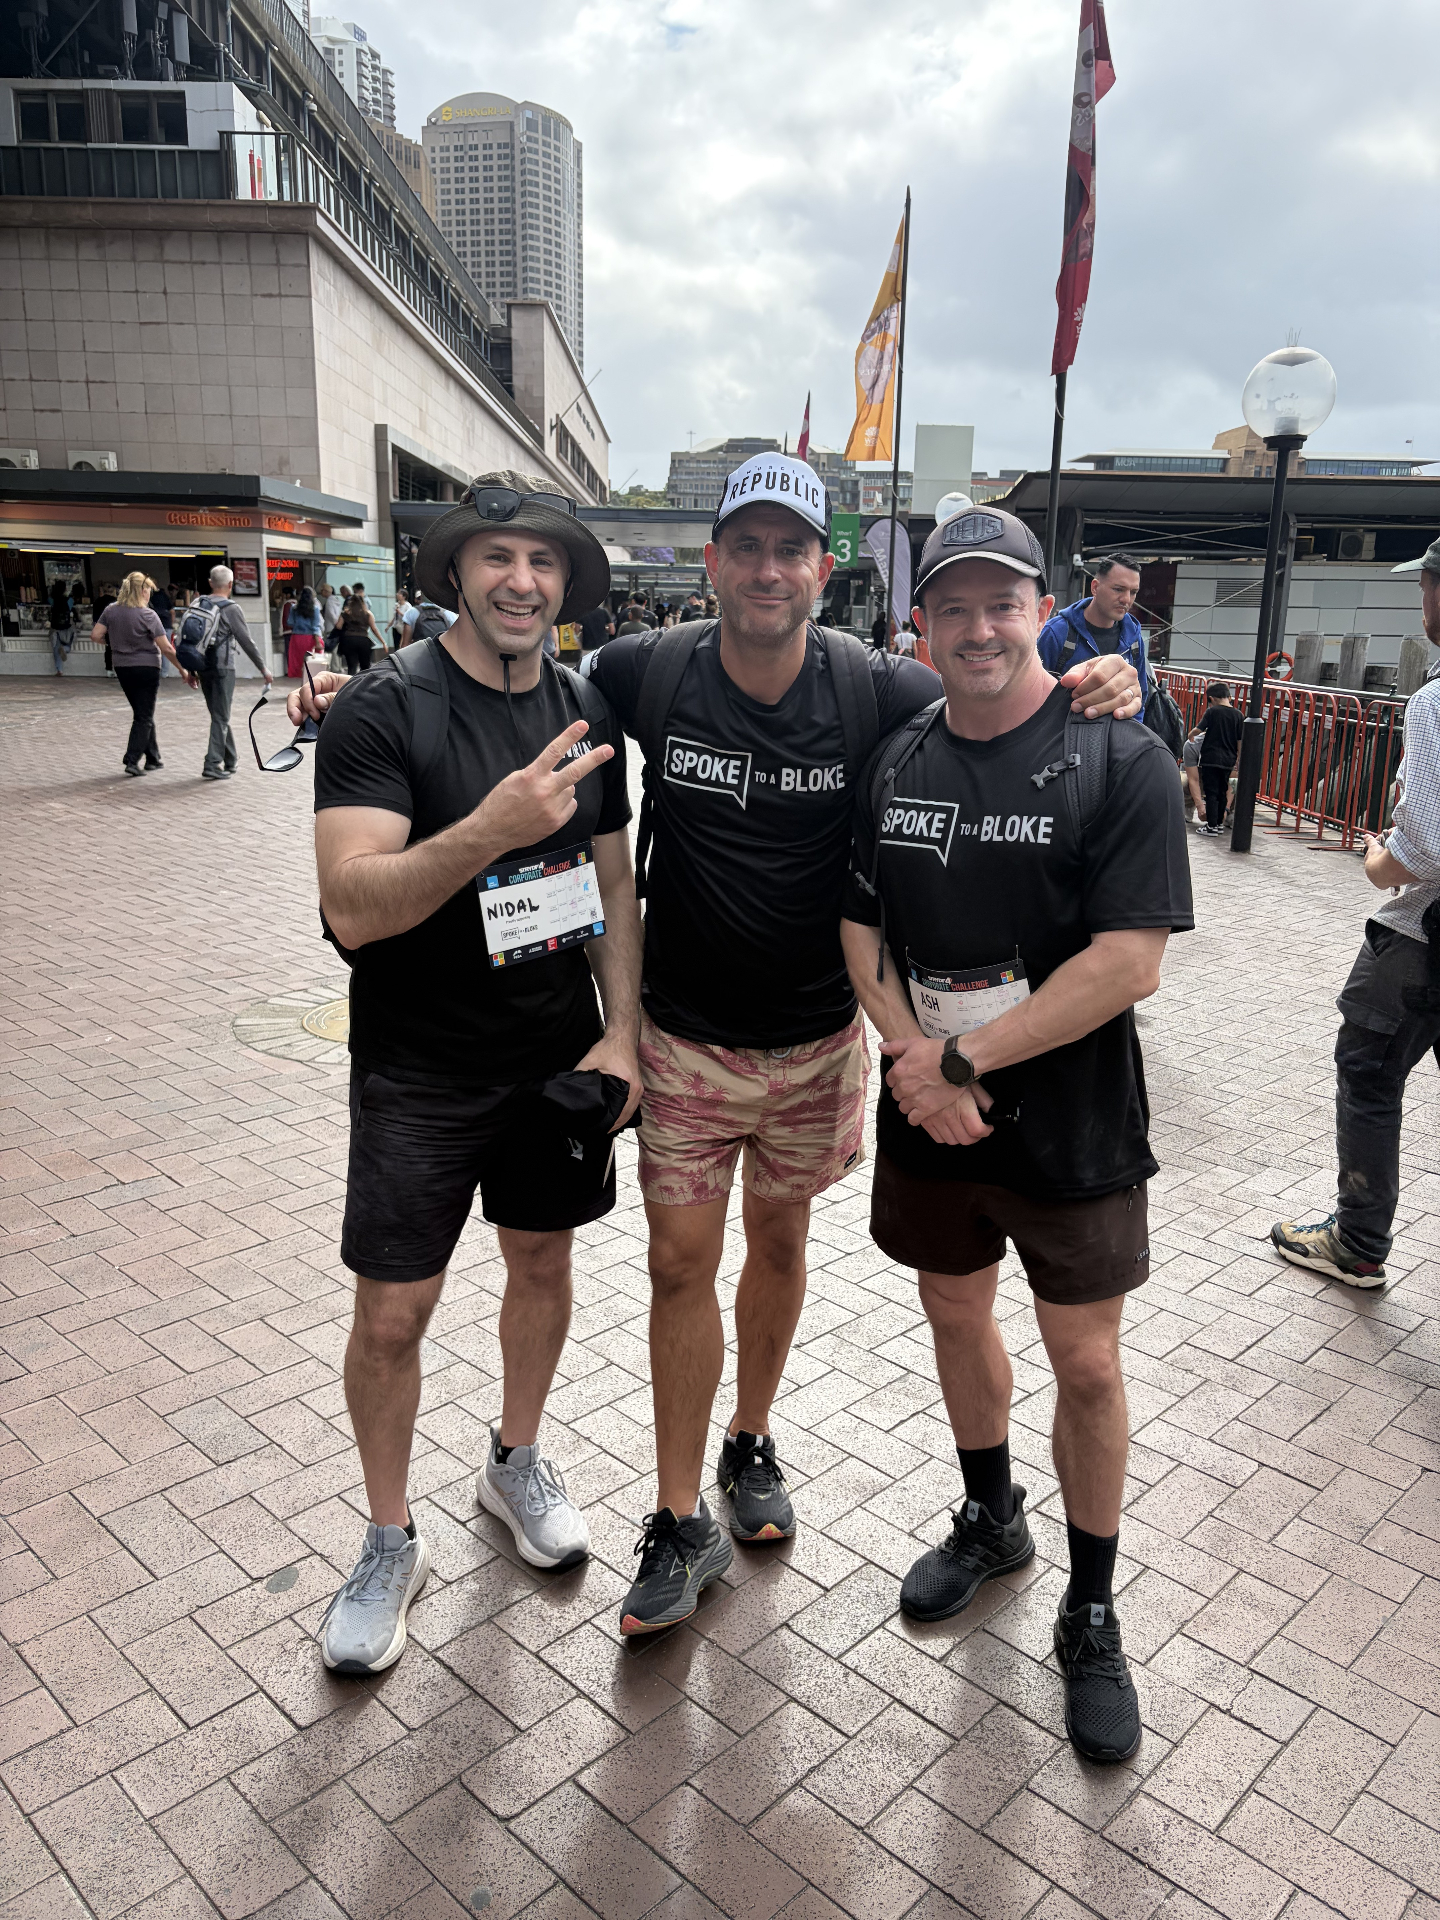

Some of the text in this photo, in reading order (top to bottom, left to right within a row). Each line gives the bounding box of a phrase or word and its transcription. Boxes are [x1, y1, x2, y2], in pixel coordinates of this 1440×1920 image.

[455, 106, 511, 118] SHANGRI-LA
[729, 471, 819, 509] REPUBLIC
[167, 511, 252, 528] Gelatissimo
[836, 539, 852, 563] 3
[670, 748, 846, 792] SPOKE TO A BLOKE
[882, 807, 1054, 845] SPOKE TO A BLOKE
[508, 869, 542, 884] CORPORATE
[543, 860, 571, 877] CHALLENGE
[487, 897, 540, 921] NIDAL
[951, 979, 990, 991] CHALLENGE
[920, 991, 941, 1013] ASH
